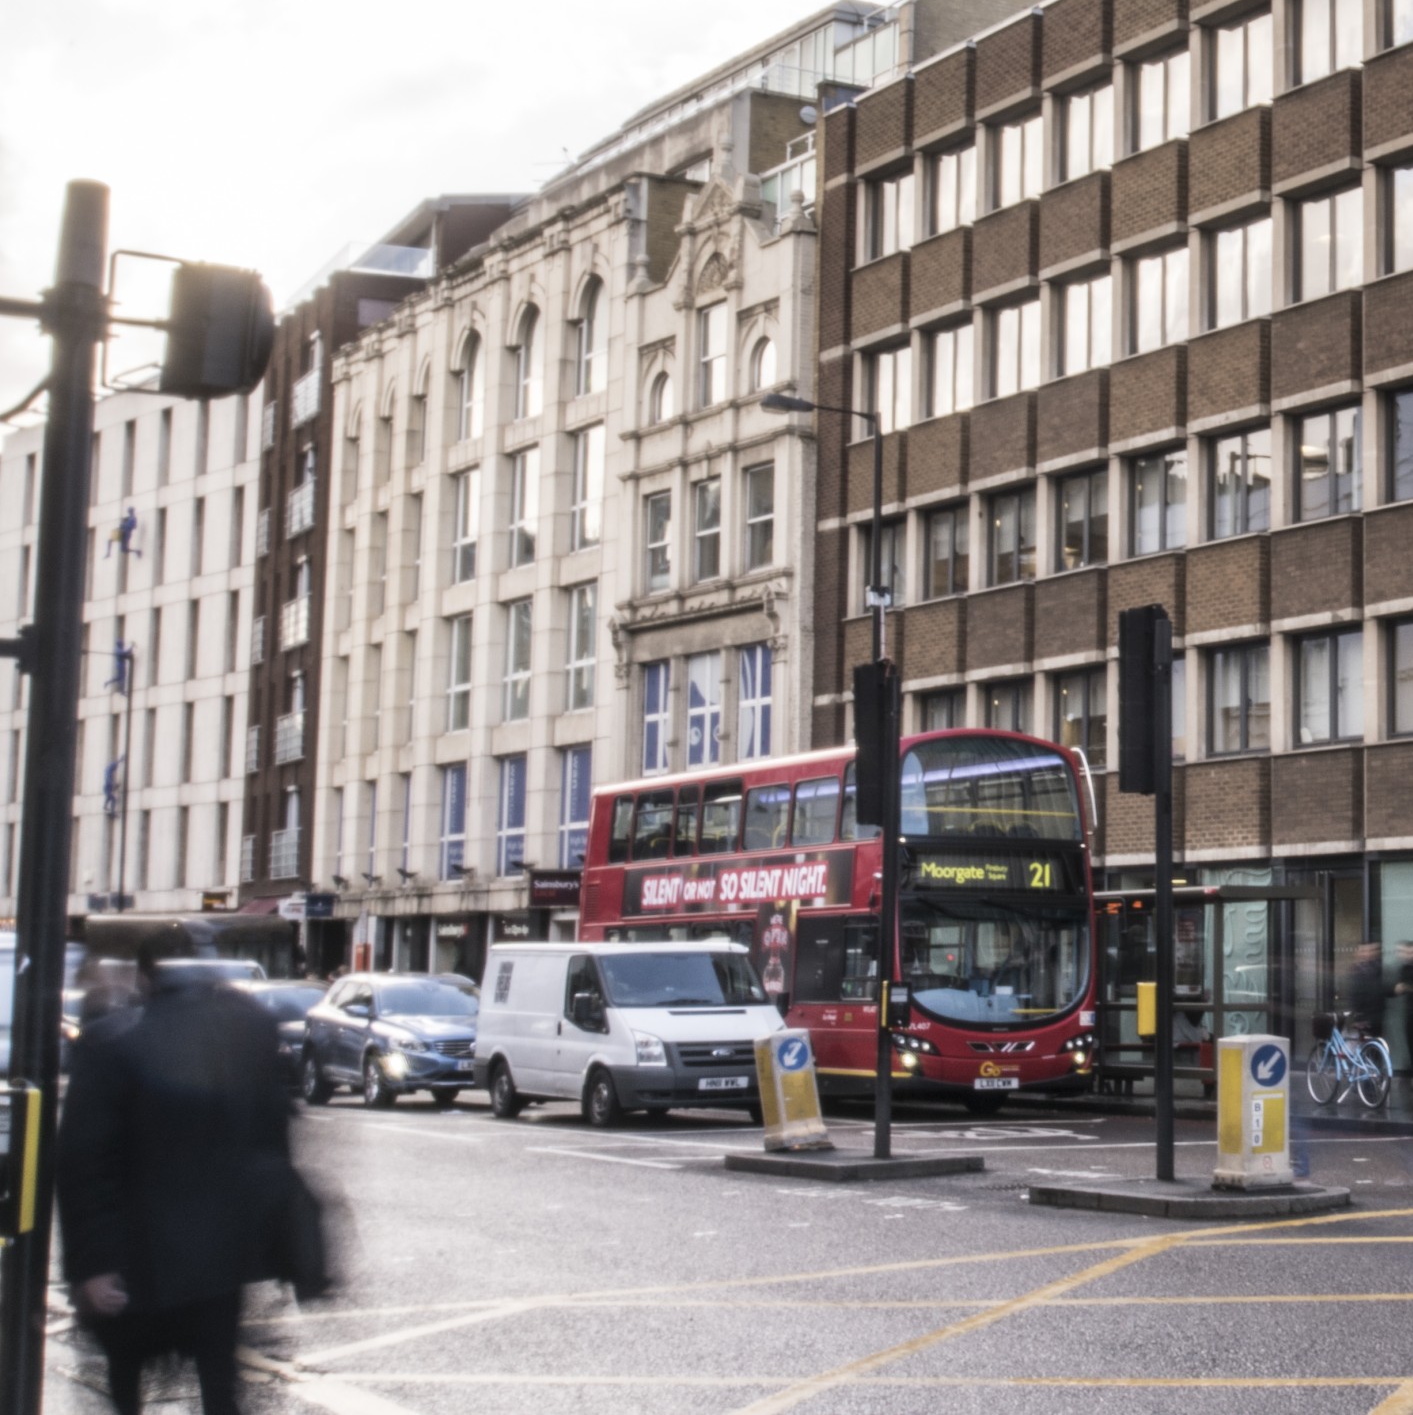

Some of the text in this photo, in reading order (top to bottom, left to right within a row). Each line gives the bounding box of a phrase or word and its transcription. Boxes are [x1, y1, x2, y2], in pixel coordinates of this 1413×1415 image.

[534, 879, 579, 891] Sainsbury's
[642, 864, 827, 906] SILENT OR NOT SO SILENT NIGHT.
[921, 862, 1051, 887] Moorgate 21
